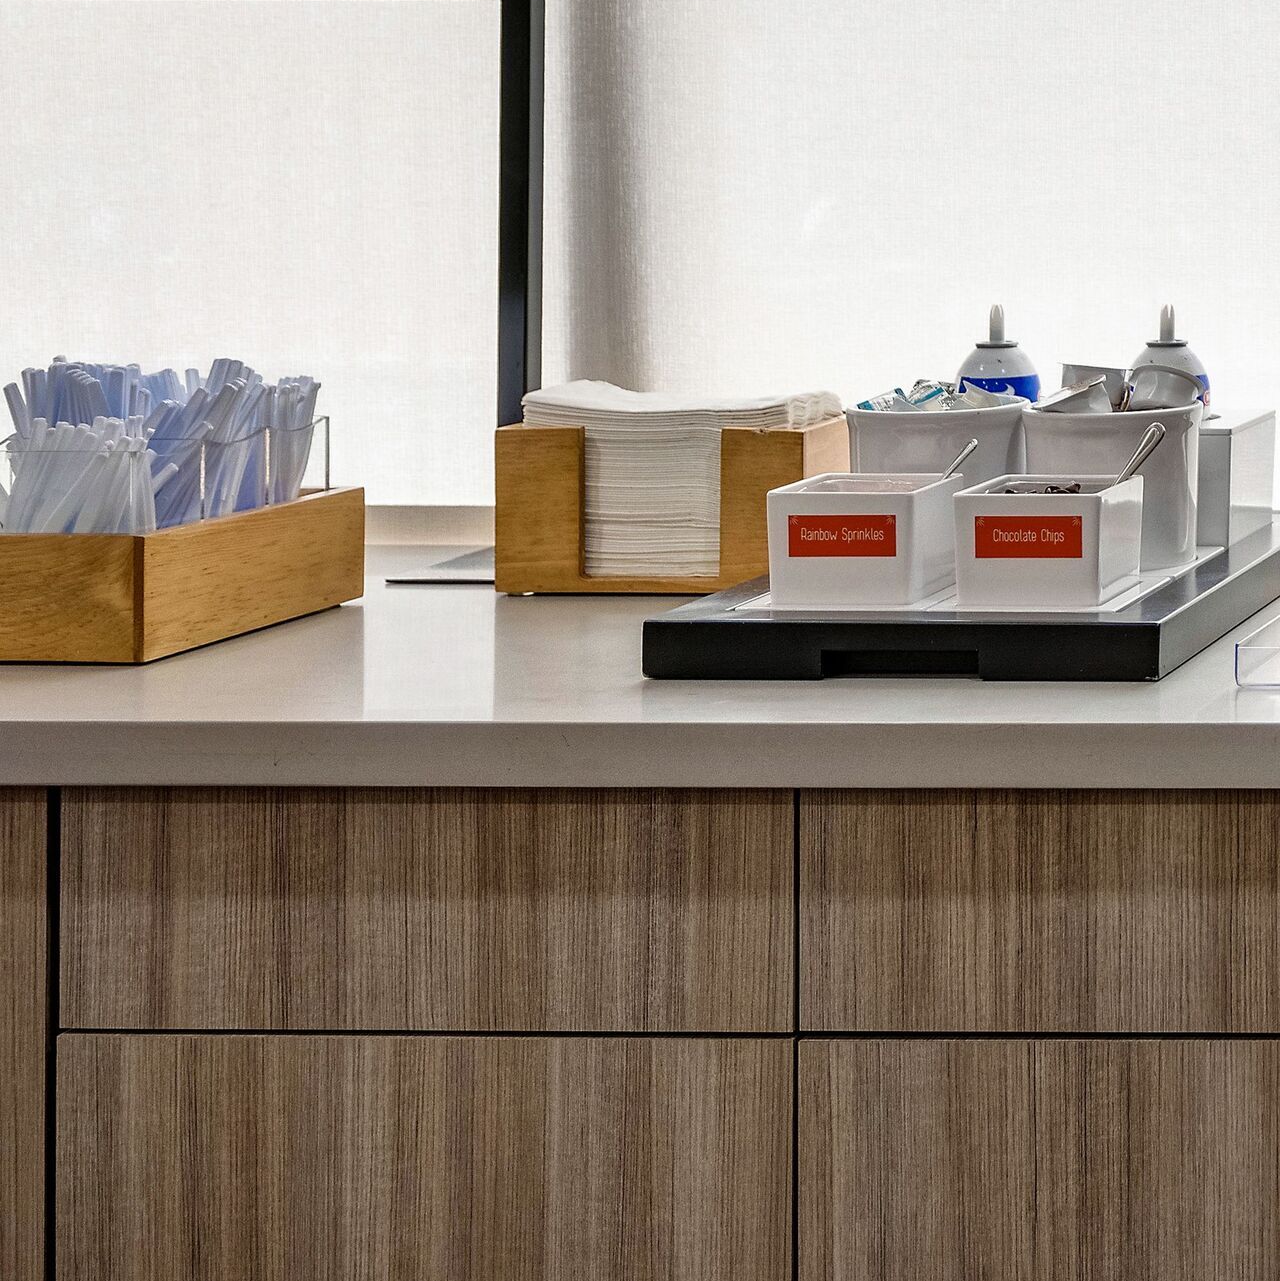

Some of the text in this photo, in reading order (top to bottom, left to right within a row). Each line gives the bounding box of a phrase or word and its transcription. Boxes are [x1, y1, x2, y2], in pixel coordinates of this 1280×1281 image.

[800, 527, 885, 543] Rainbow Sprinkles
[992, 528, 1065, 545] Chocolate Chips
